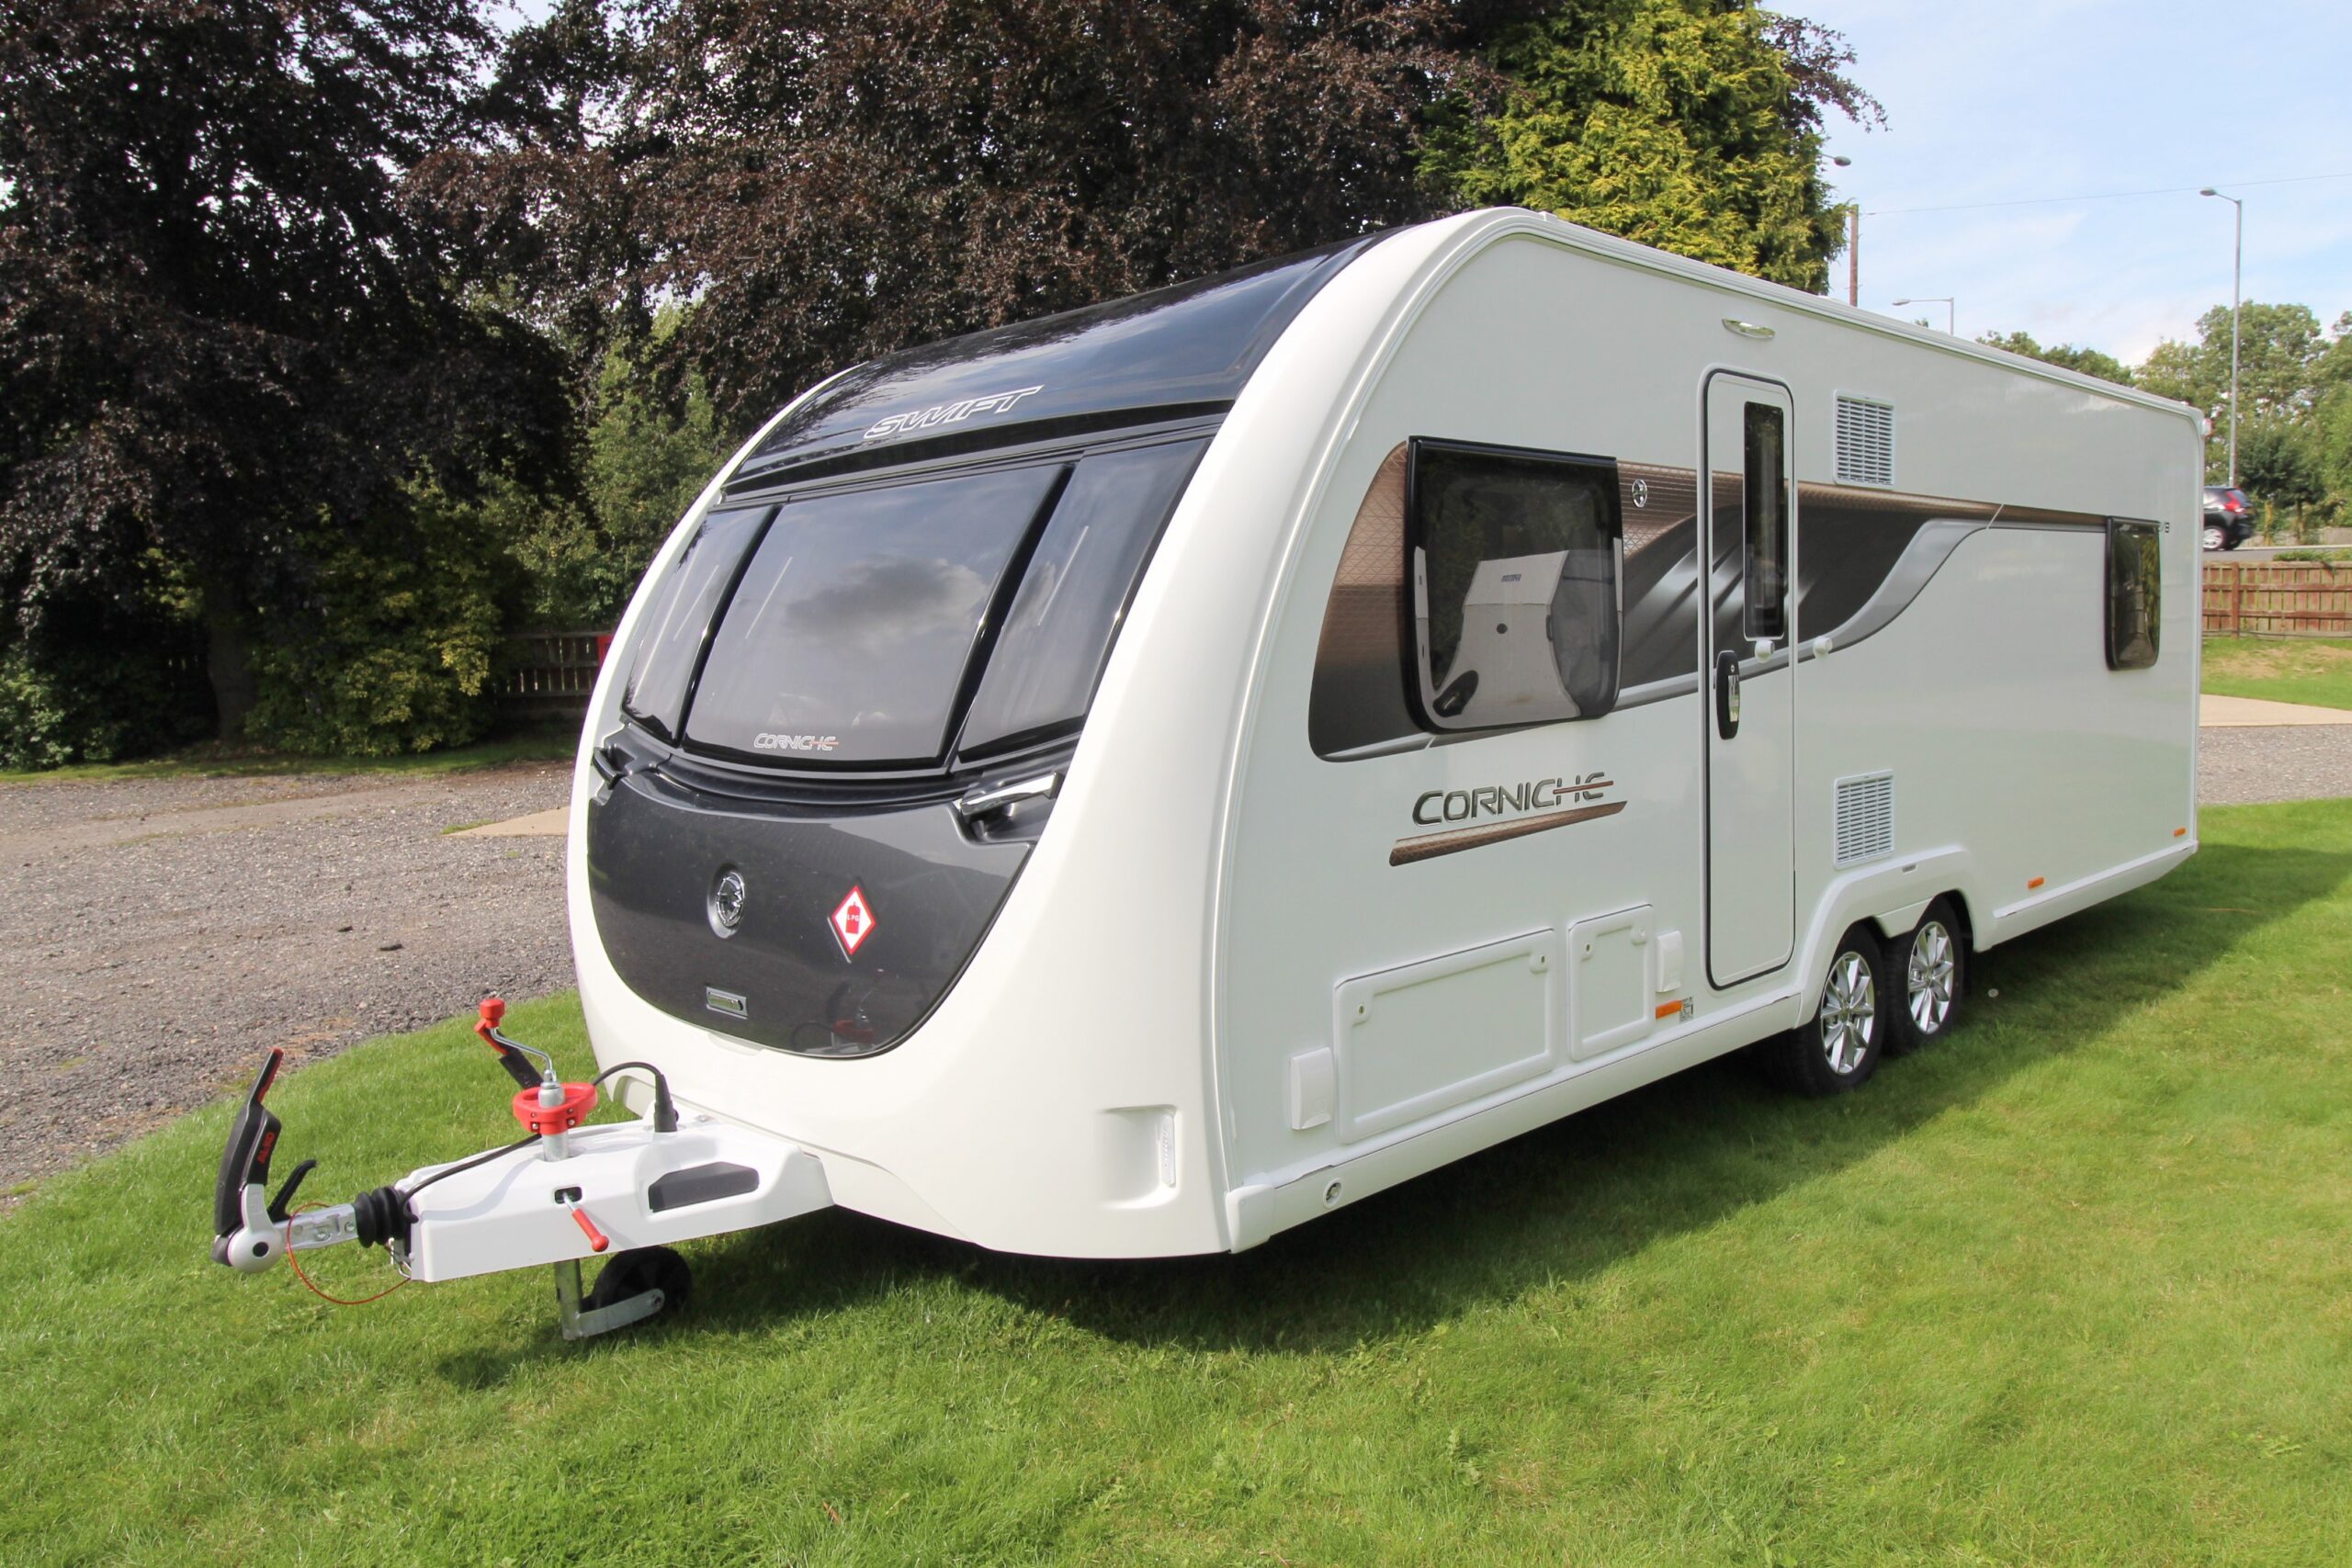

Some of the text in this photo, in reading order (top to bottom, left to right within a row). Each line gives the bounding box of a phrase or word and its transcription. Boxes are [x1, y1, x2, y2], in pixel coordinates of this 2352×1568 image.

[864, 384, 1045, 439] SWIFT
[753, 733, 839, 751] CORNICHE
[1412, 772, 1613, 826] CORNICHE
